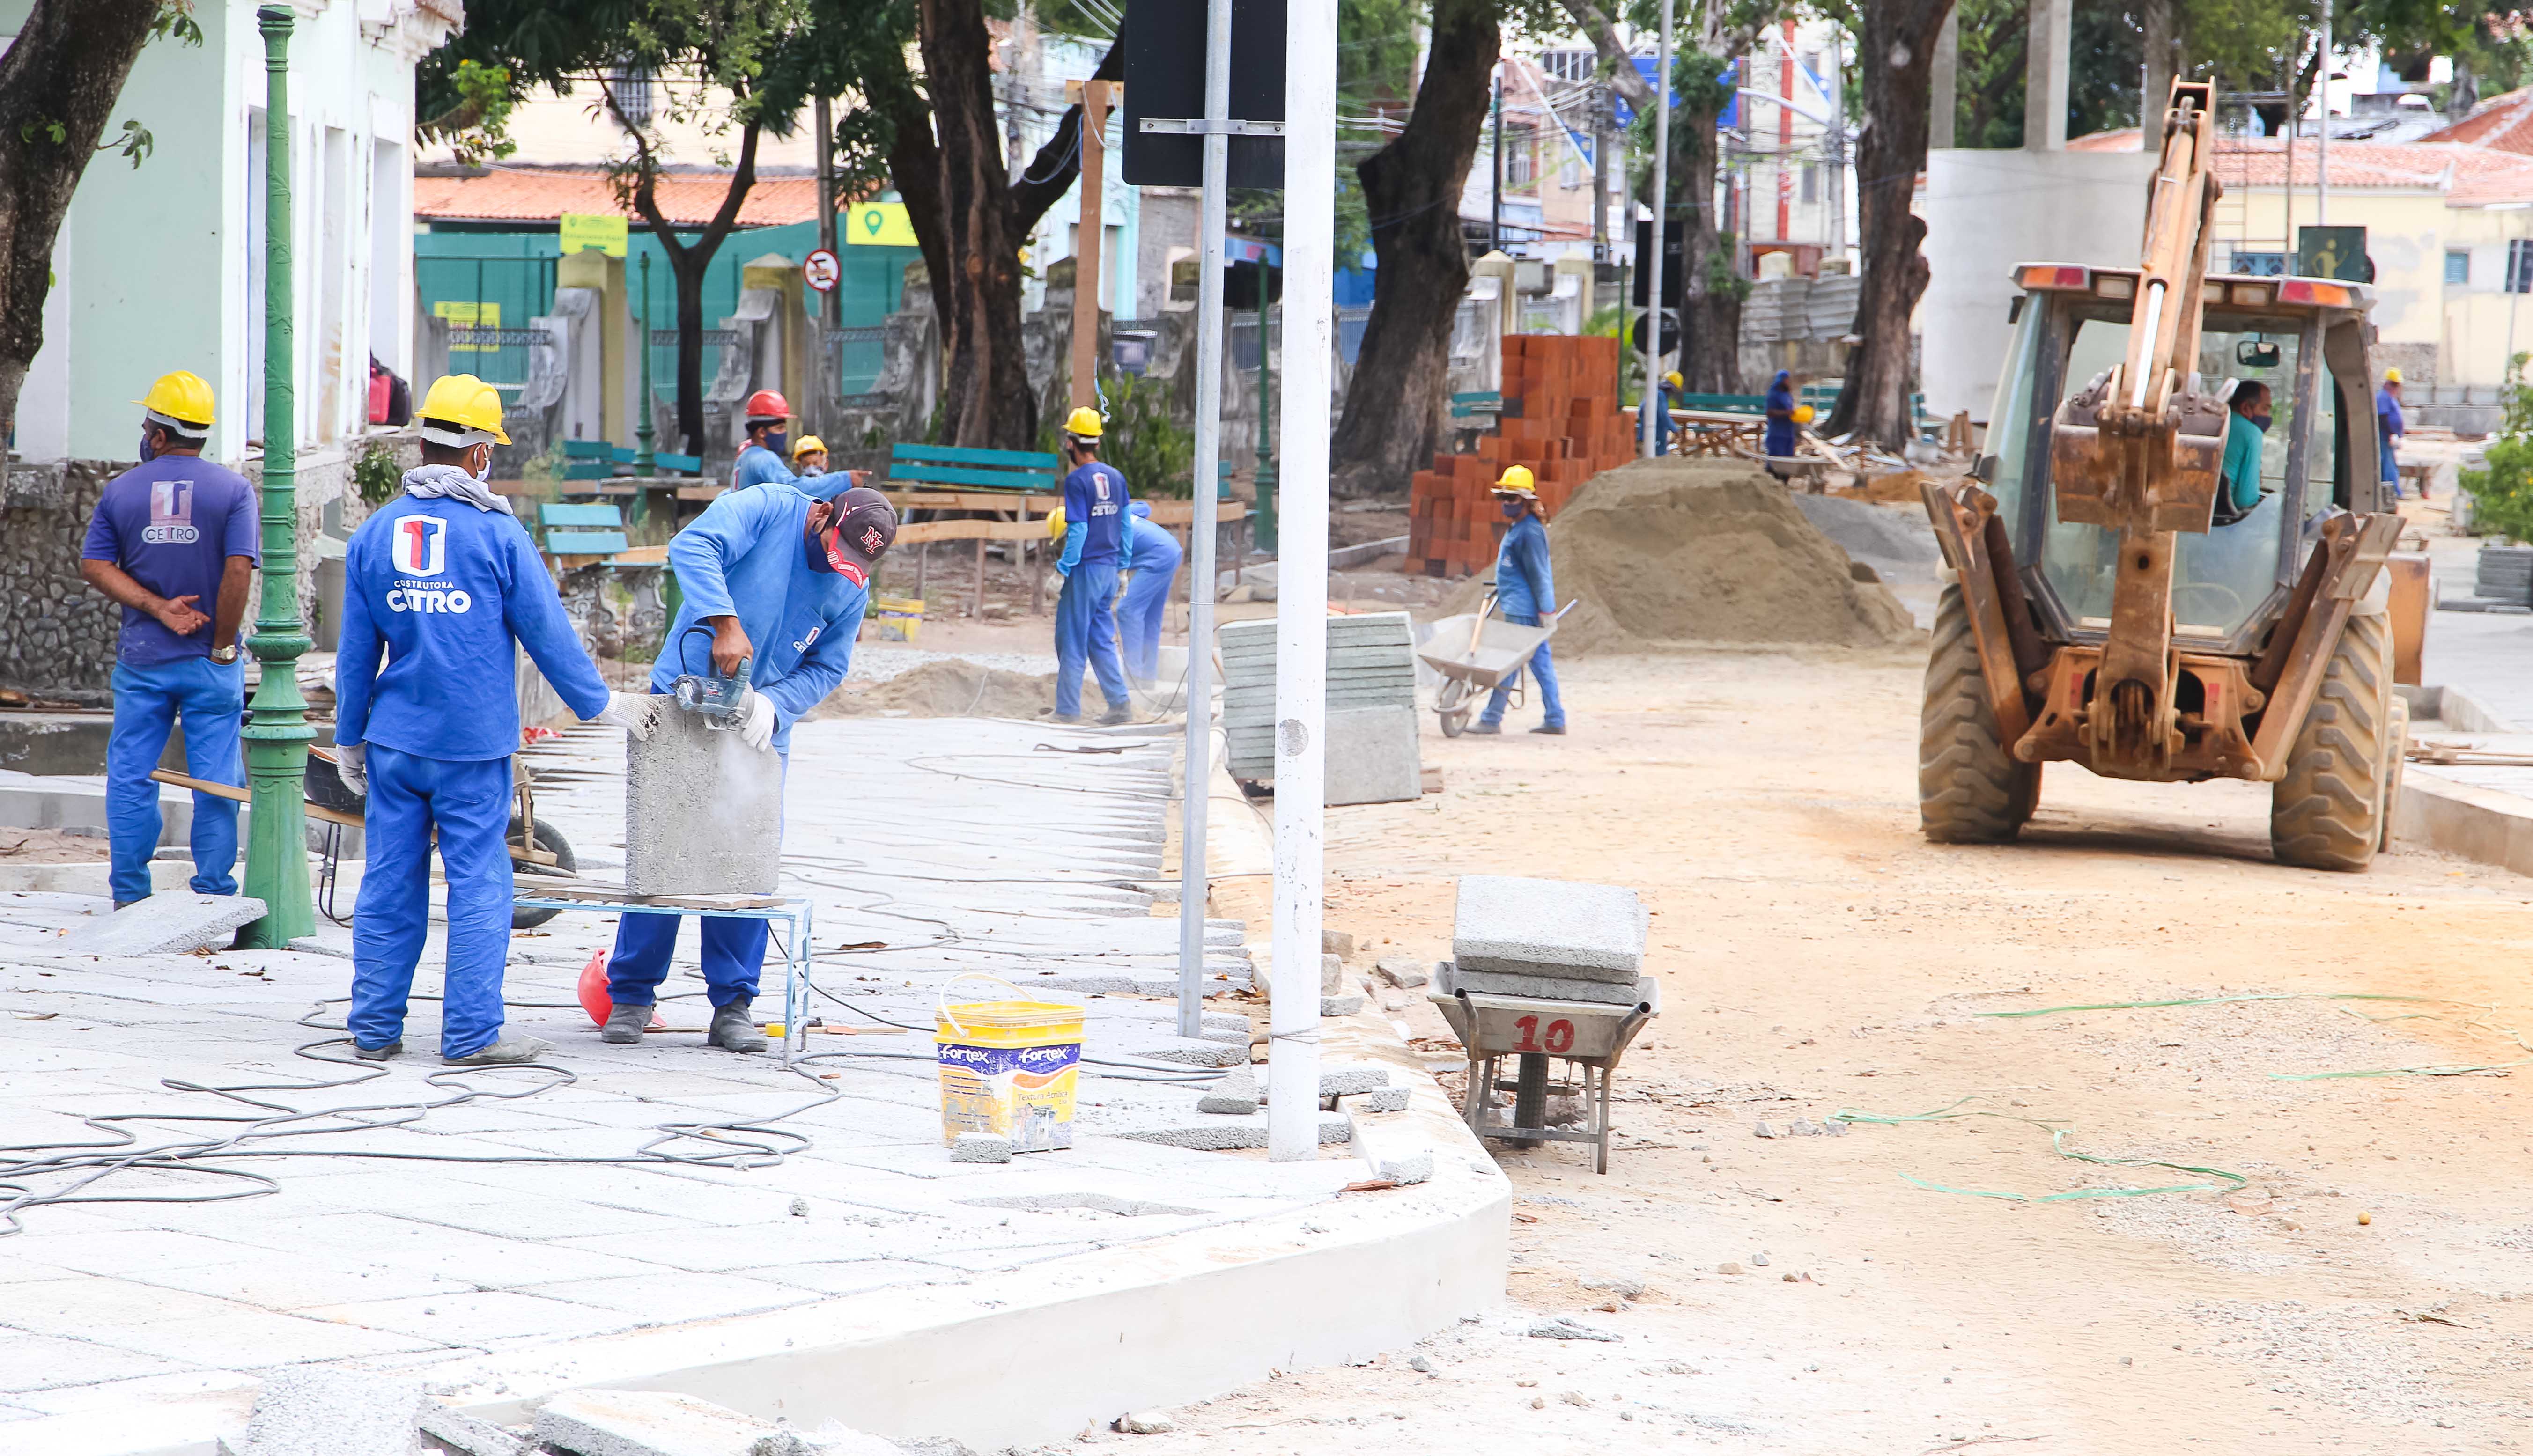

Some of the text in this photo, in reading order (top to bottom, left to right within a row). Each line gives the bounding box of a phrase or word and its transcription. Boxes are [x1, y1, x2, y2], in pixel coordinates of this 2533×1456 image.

[146, 526, 196, 540] CETRO
[861, 526, 884, 554] NY
[386, 588, 472, 614] CTRO
[1513, 1015, 1574, 1053] 10
